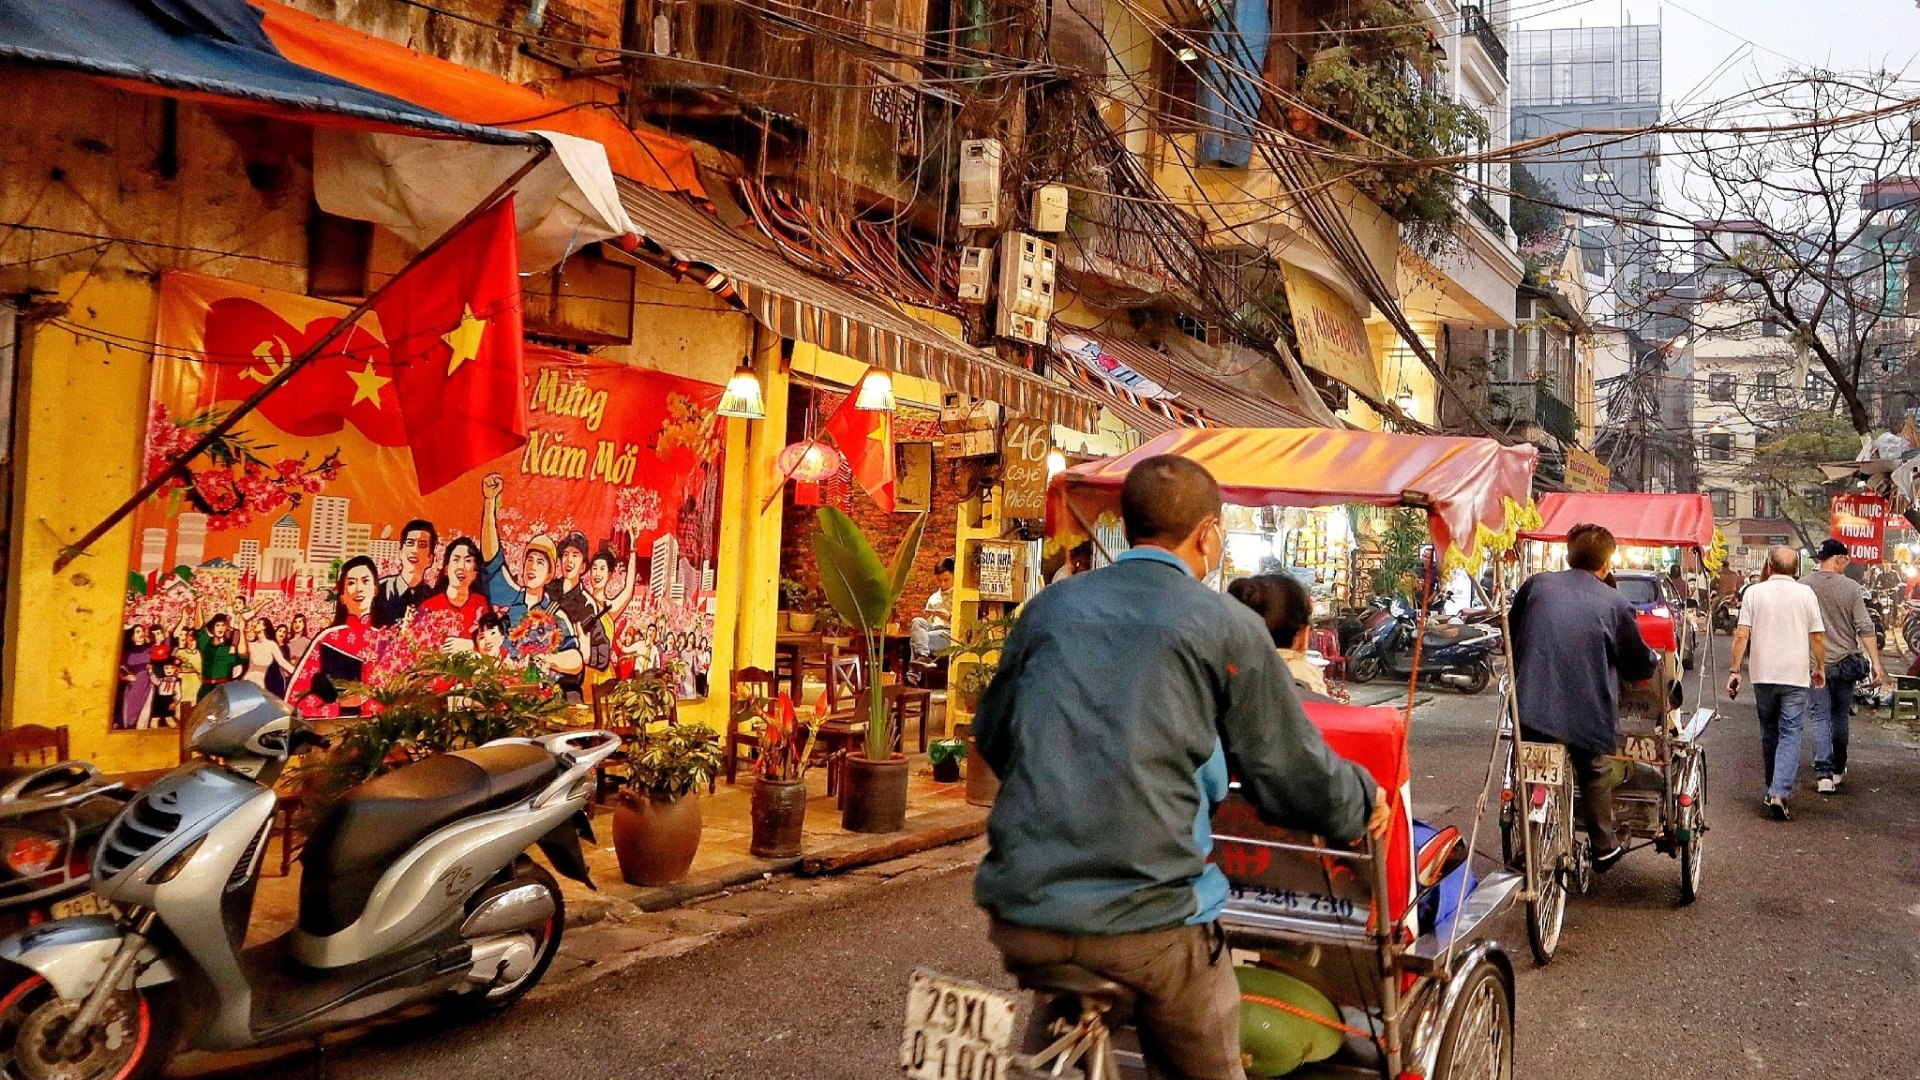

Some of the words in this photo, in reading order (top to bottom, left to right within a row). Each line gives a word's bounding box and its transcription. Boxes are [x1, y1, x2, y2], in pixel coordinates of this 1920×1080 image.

[530, 367, 608, 431] Mừng
[521, 431, 587, 478] Năm
[590, 441, 639, 485] Mới
[1008, 422, 1047, 461] 46
[1851, 545, 1879, 559] LONG
[925, 987, 991, 1042] 29XL
